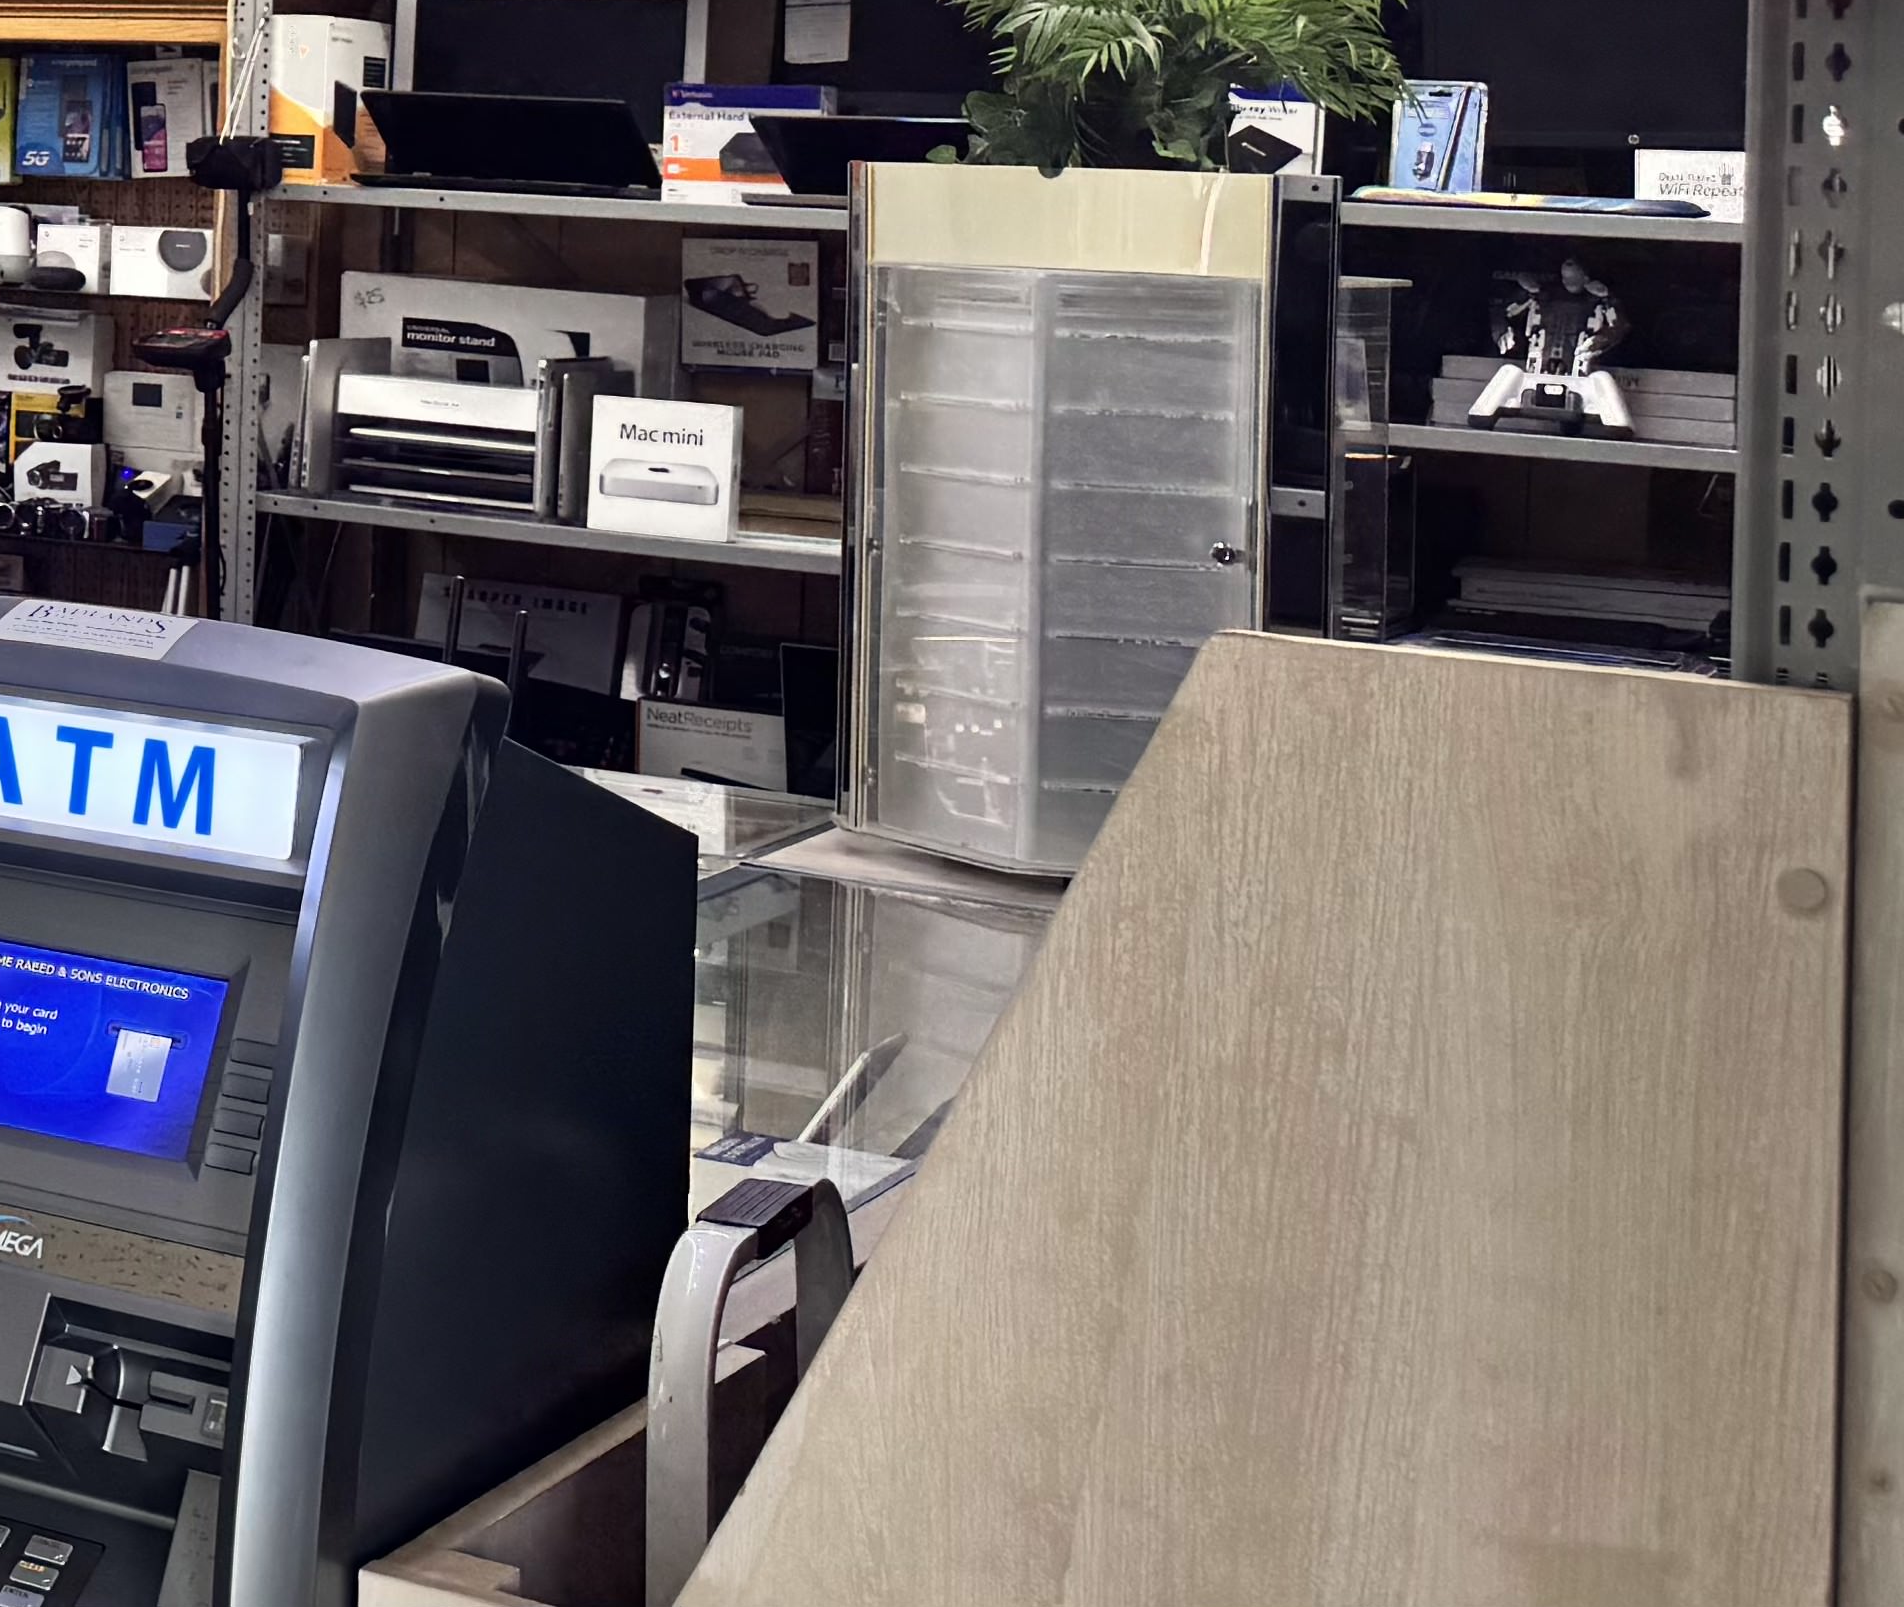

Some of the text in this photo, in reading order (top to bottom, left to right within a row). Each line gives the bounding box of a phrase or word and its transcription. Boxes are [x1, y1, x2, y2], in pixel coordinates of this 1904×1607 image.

[668, 110, 745, 122] External Hard
[22, 150, 50, 166] 5G
[1660, 183, 1690, 195] WiFi
[407, 332, 496, 348] monitor stand
[620, 423, 703, 446] Mac mini
[646, 707, 753, 733] NeatReceipts
[57, 965, 68, 979] &
[69, 967, 104, 987] SONS
[105, 974, 190, 1001] ELECTRONICS
[3, 1001, 30, 1018] your
[31, 1004, 60, 1021] card
[1, 1016, 14, 1030] to
[15, 1017, 48, 1037] begin
